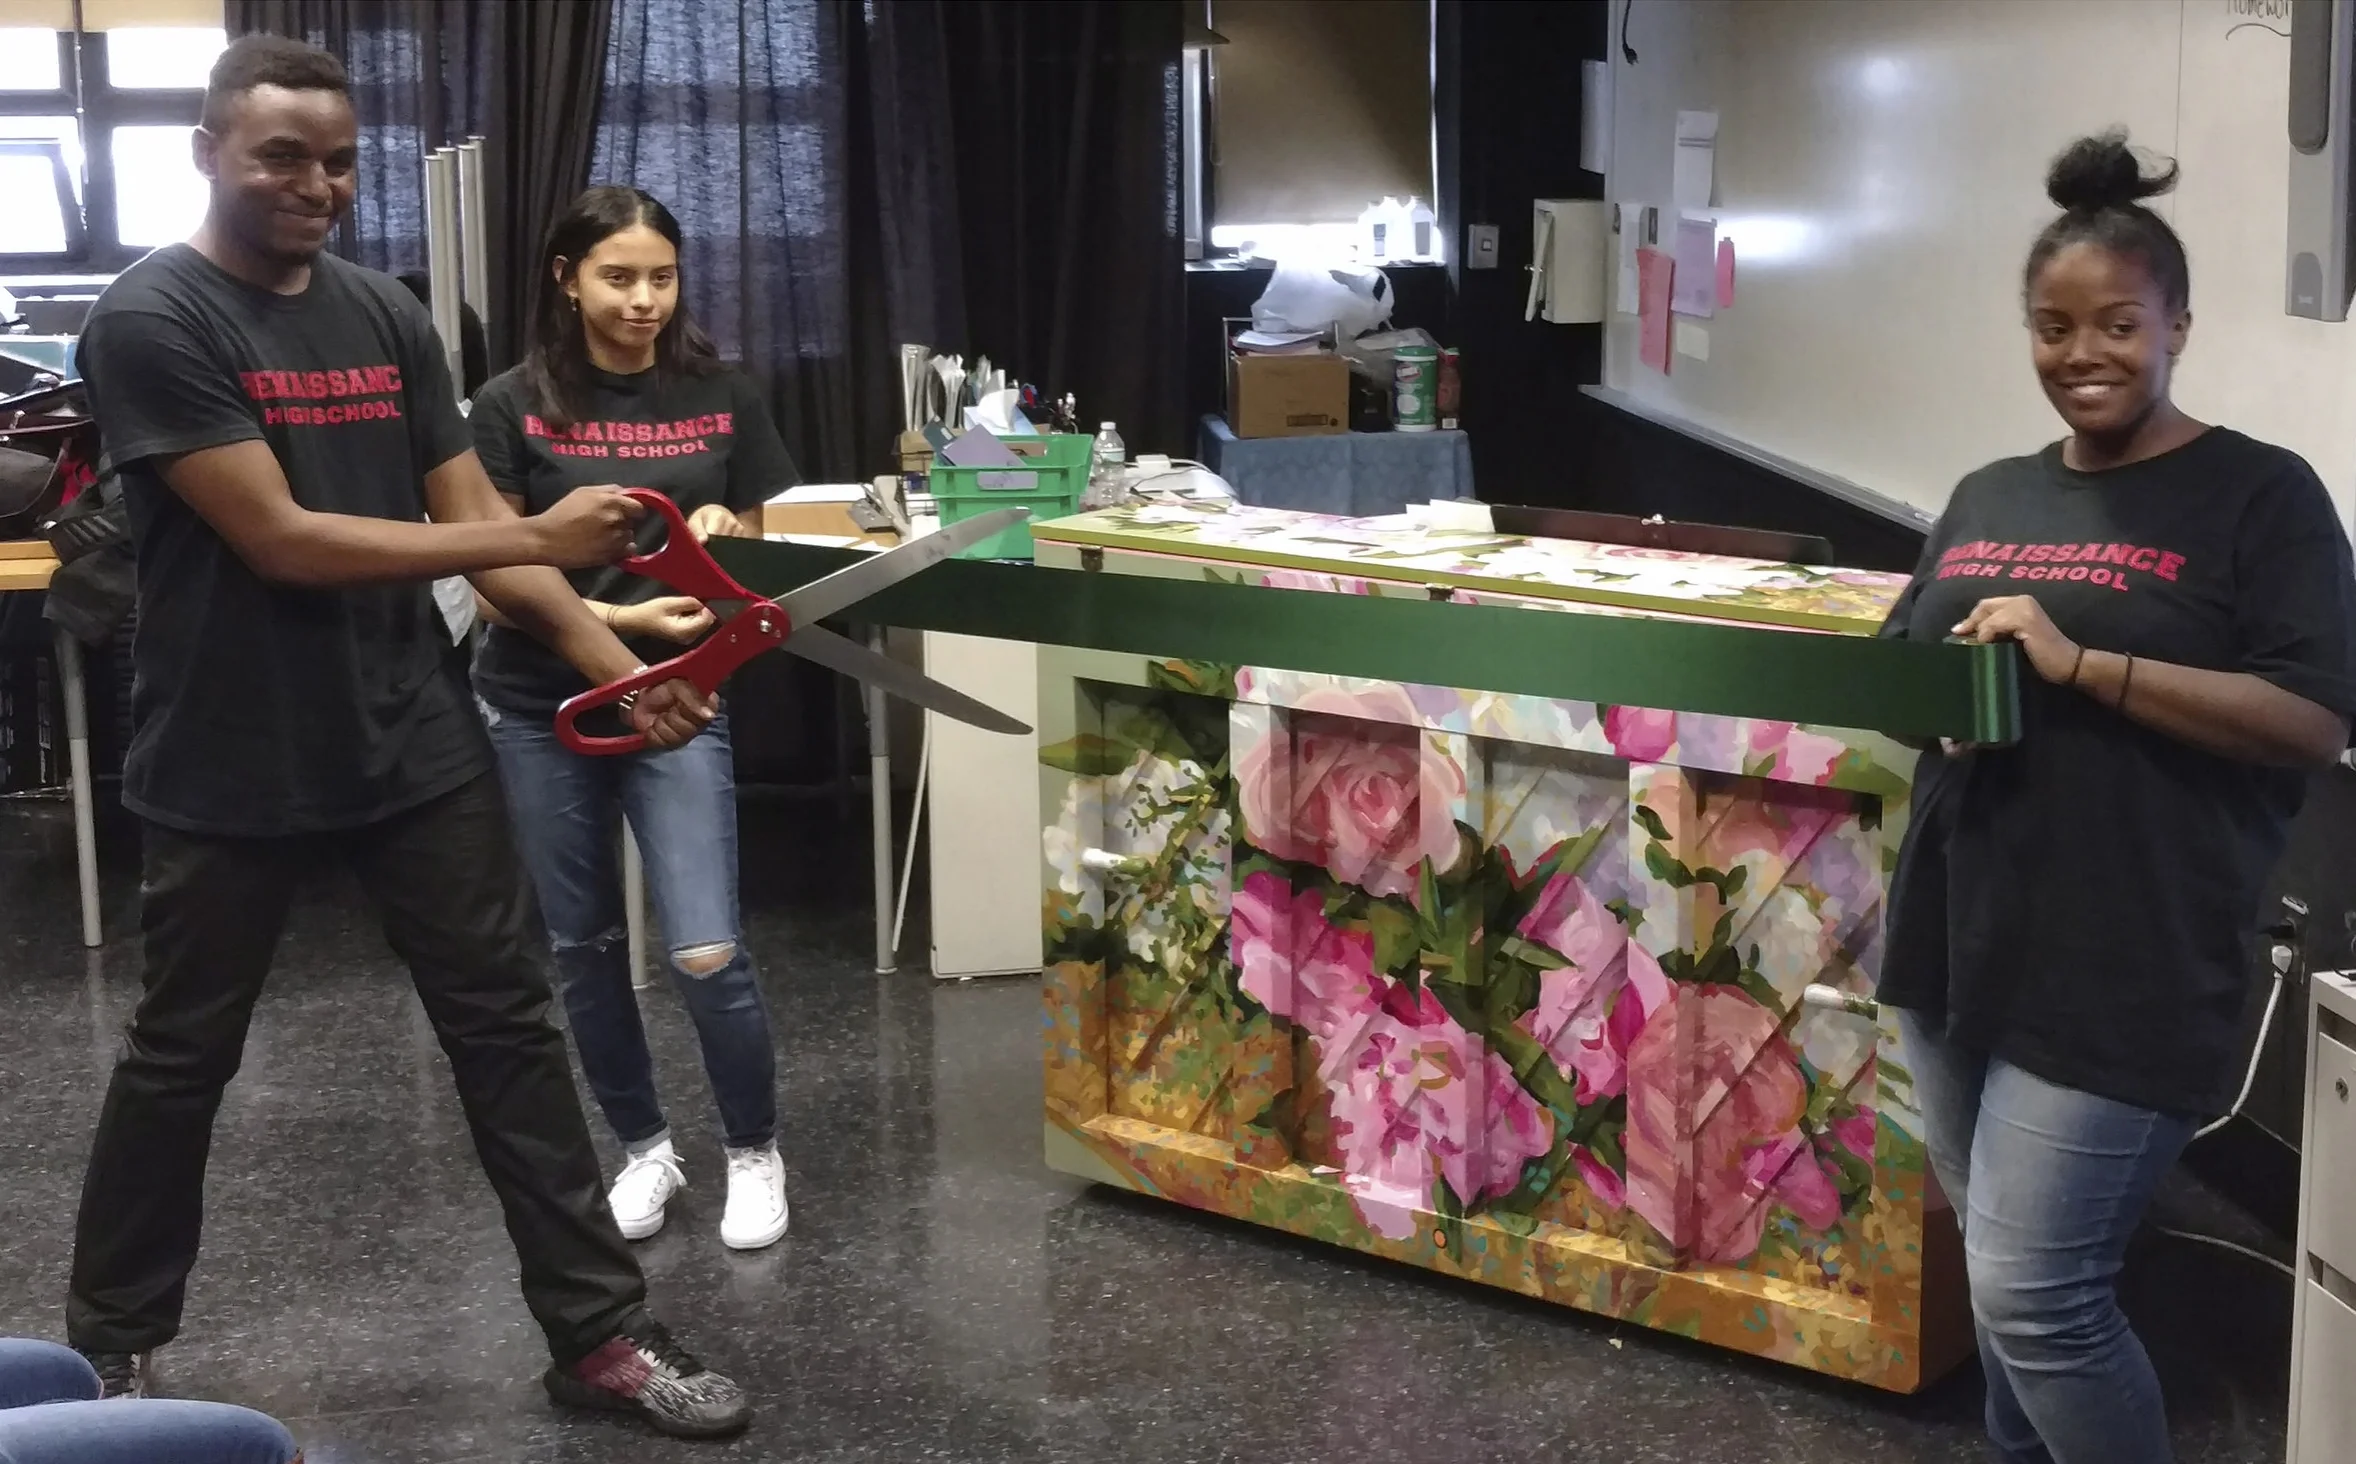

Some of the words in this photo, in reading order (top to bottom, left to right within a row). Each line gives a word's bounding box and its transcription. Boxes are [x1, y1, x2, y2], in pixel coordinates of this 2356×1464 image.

[311, 401, 401, 425] SCHOOL
[524, 412, 733, 441] RAISSANCE
[551, 443, 608, 457] HIGH
[617, 440, 709, 458] SCHOOL
[2009, 566, 2128, 591] SCHOOL
